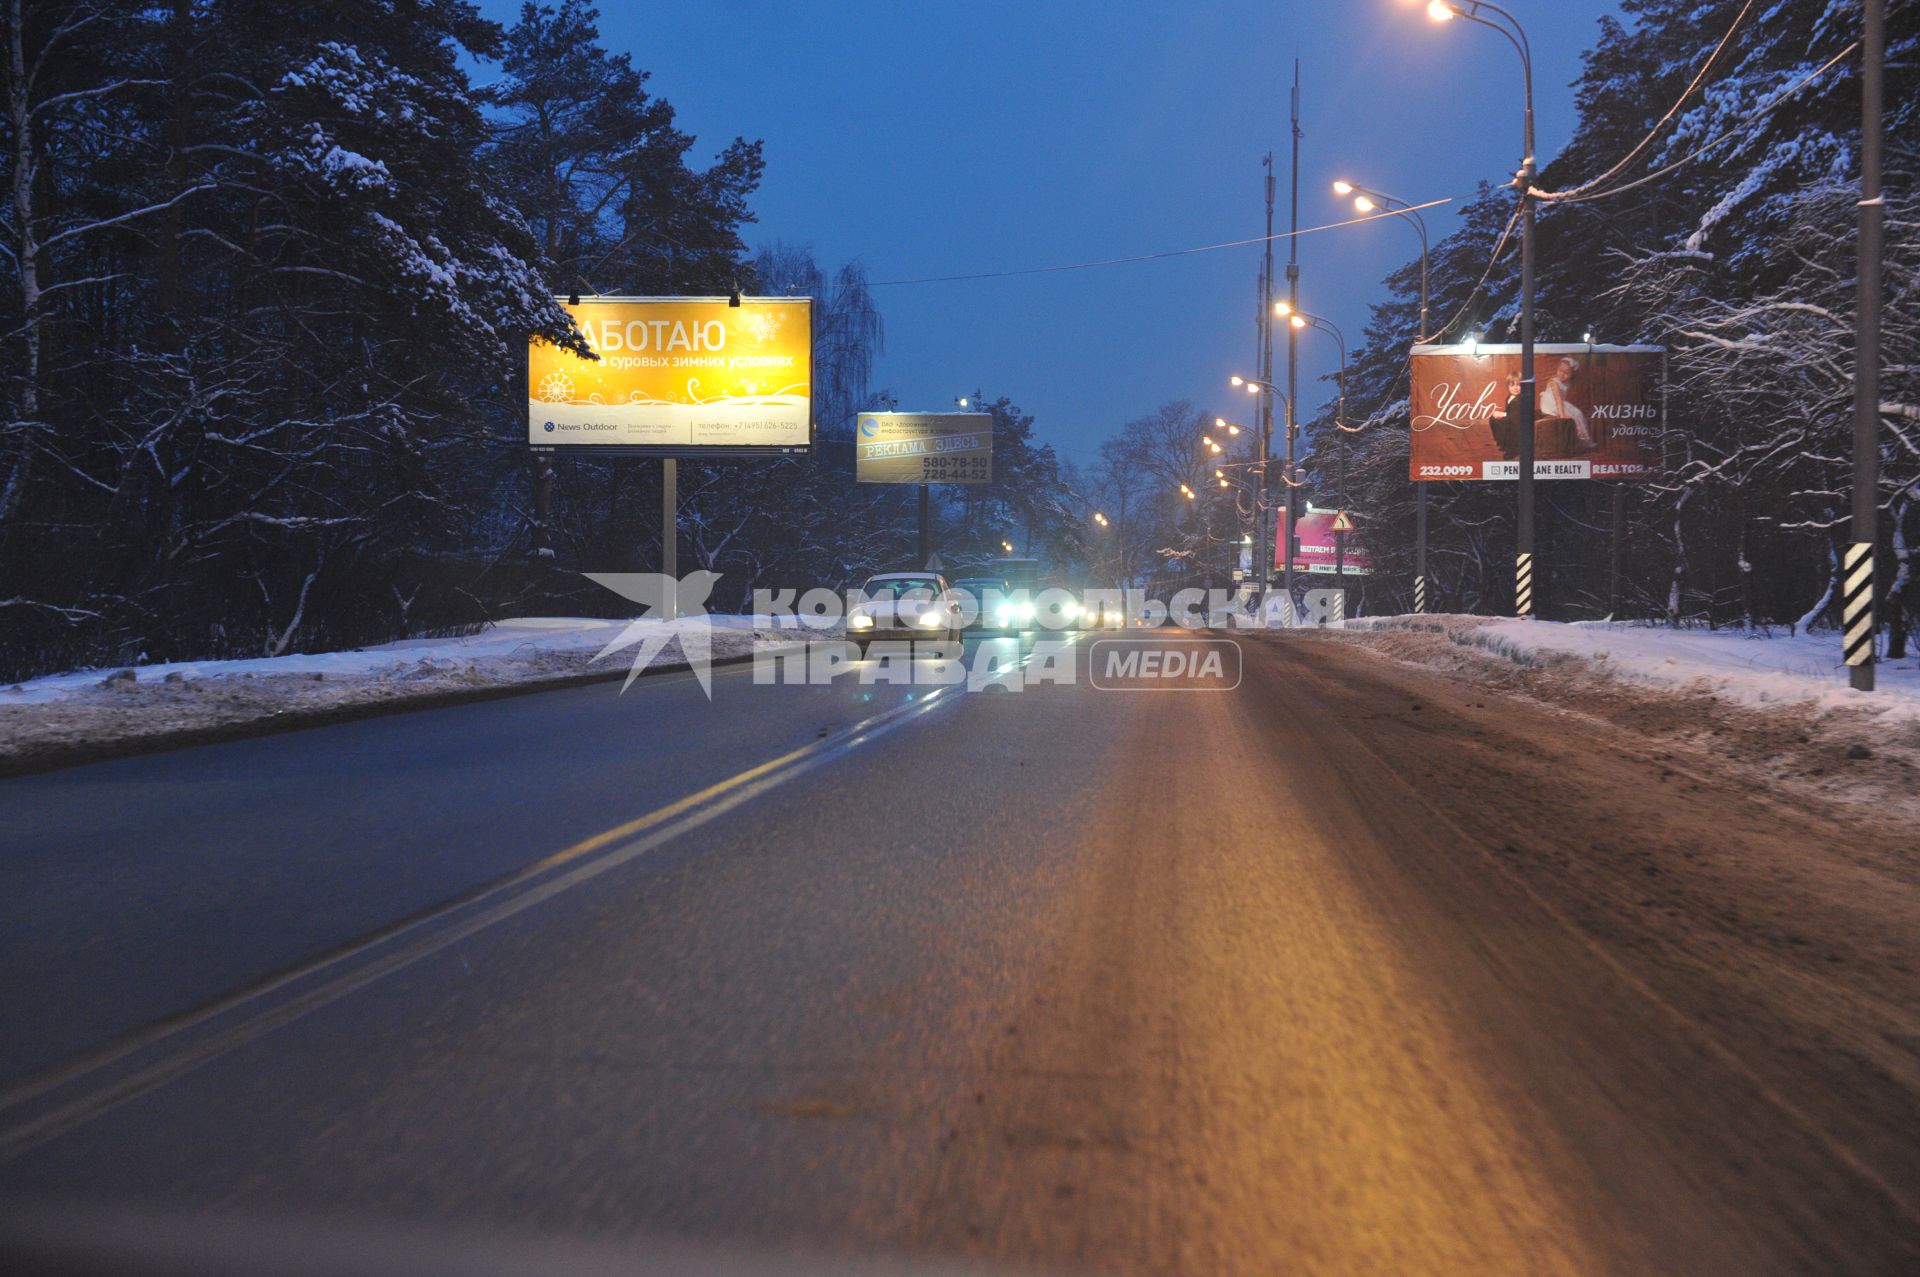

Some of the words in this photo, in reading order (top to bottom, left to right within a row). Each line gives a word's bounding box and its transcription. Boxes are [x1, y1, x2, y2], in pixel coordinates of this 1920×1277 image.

[579, 319, 726, 352] АБОТАЮ
[610, 357, 669, 371] суровых
[673, 358, 725, 368] зимних
[728, 357, 793, 370] условиях
[1411, 380, 1502, 431] Усово
[1591, 403, 1657, 419] жизнь
[557, 422, 581, 431] News
[583, 422, 618, 431] Outdoor
[744, 421, 762, 431] (495)
[764, 421, 798, 431] 626-5225
[865, 440, 928, 457] РЕКЛАМА
[935, 436, 979, 452] ЗДЕСЬ
[923, 457, 988, 468] 580-78-50
[923, 469, 987, 480] 728-44-52
[1420, 465, 1473, 476] 232.0099
[1533, 464, 1552, 475] ANE
[1554, 464, 1582, 475] REALTY
